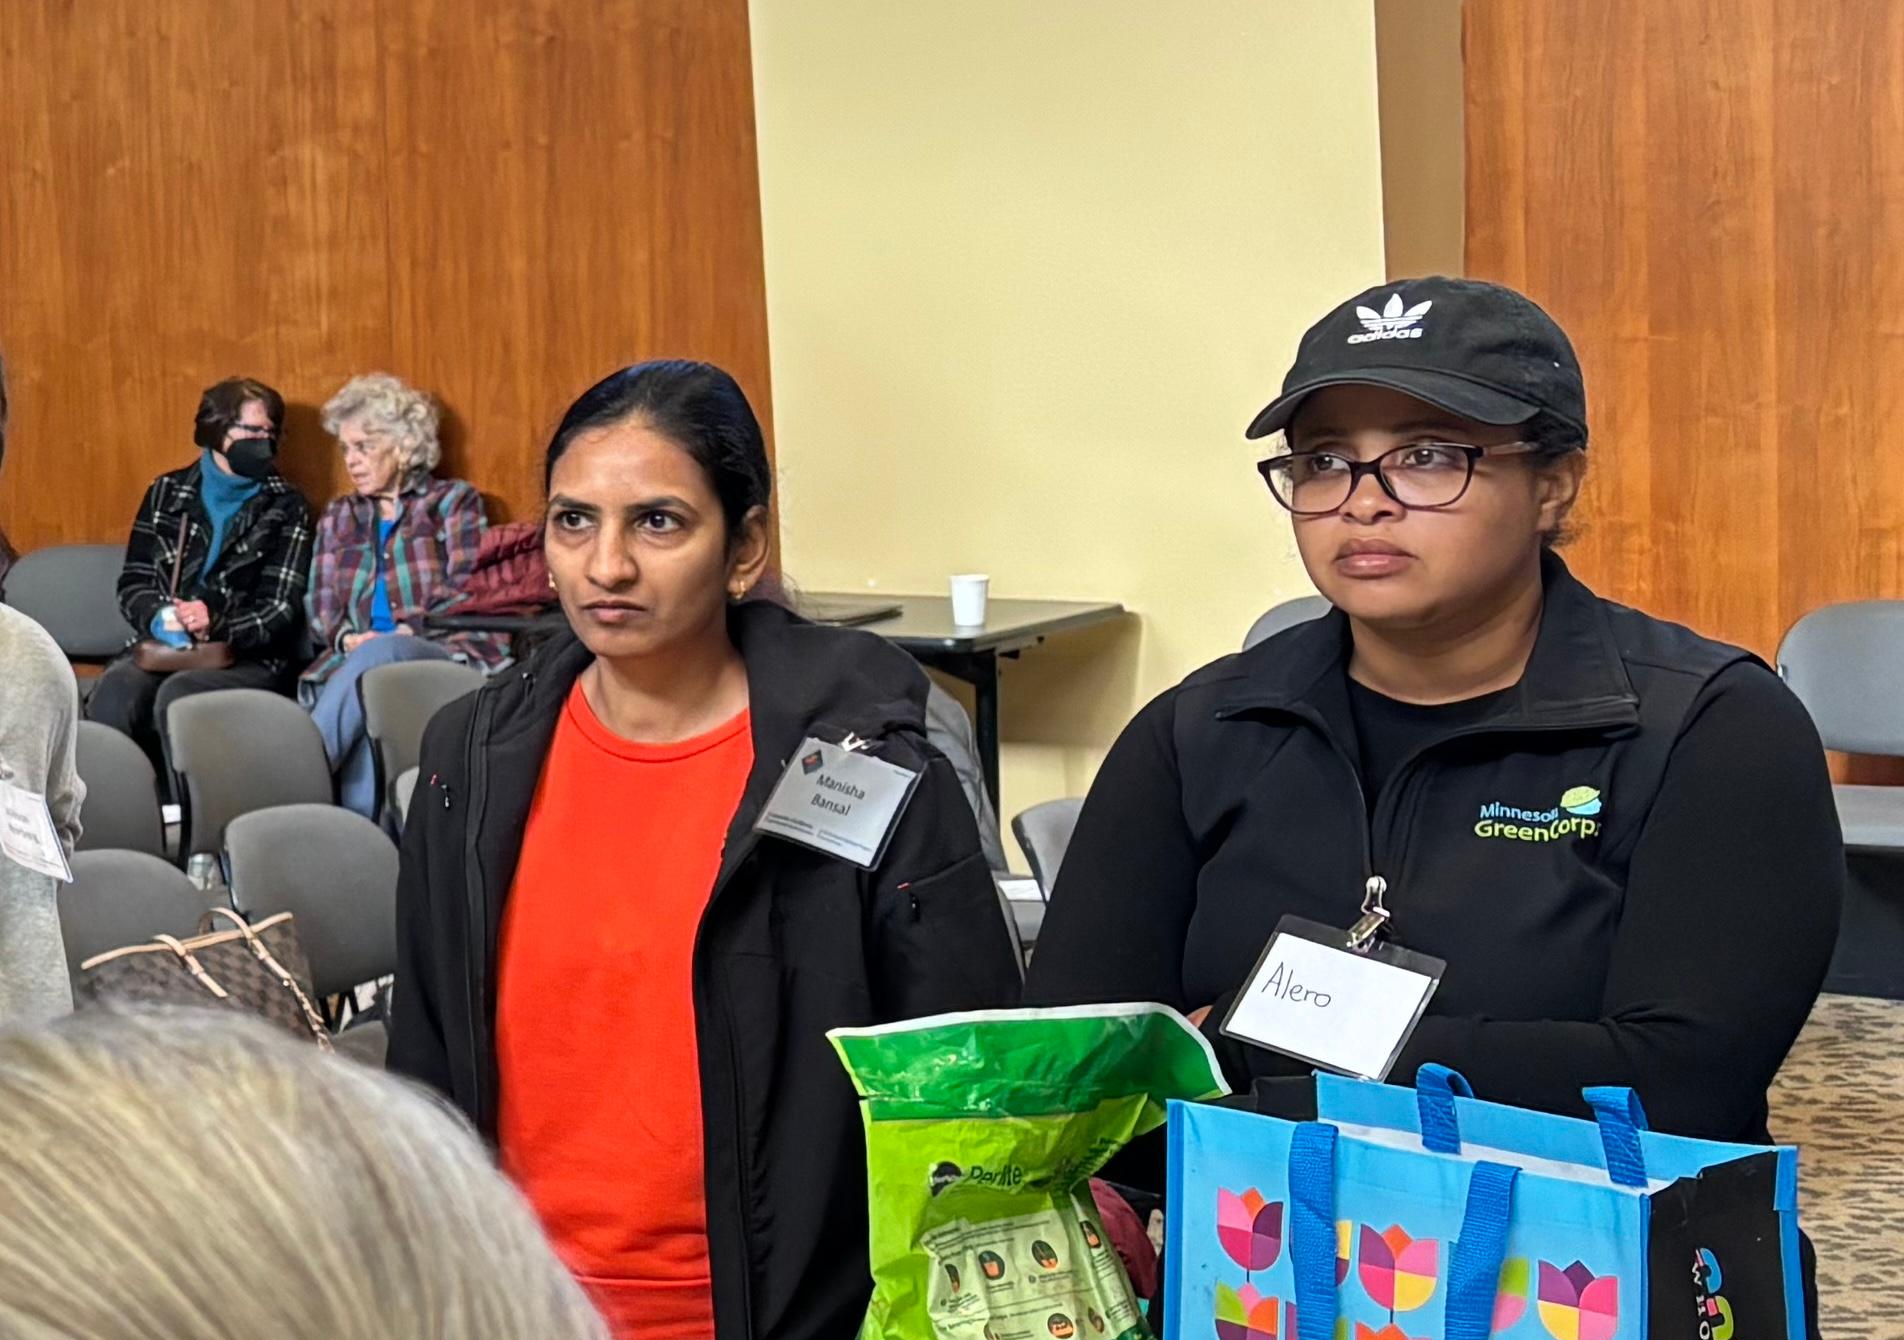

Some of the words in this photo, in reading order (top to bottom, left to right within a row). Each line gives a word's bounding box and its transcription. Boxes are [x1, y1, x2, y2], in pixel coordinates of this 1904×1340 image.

[1347, 327, 1424, 345] adidas
[815, 773, 867, 801] Manisha
[810, 793, 852, 816] Bansal
[1261, 962, 1332, 1008] Alero
